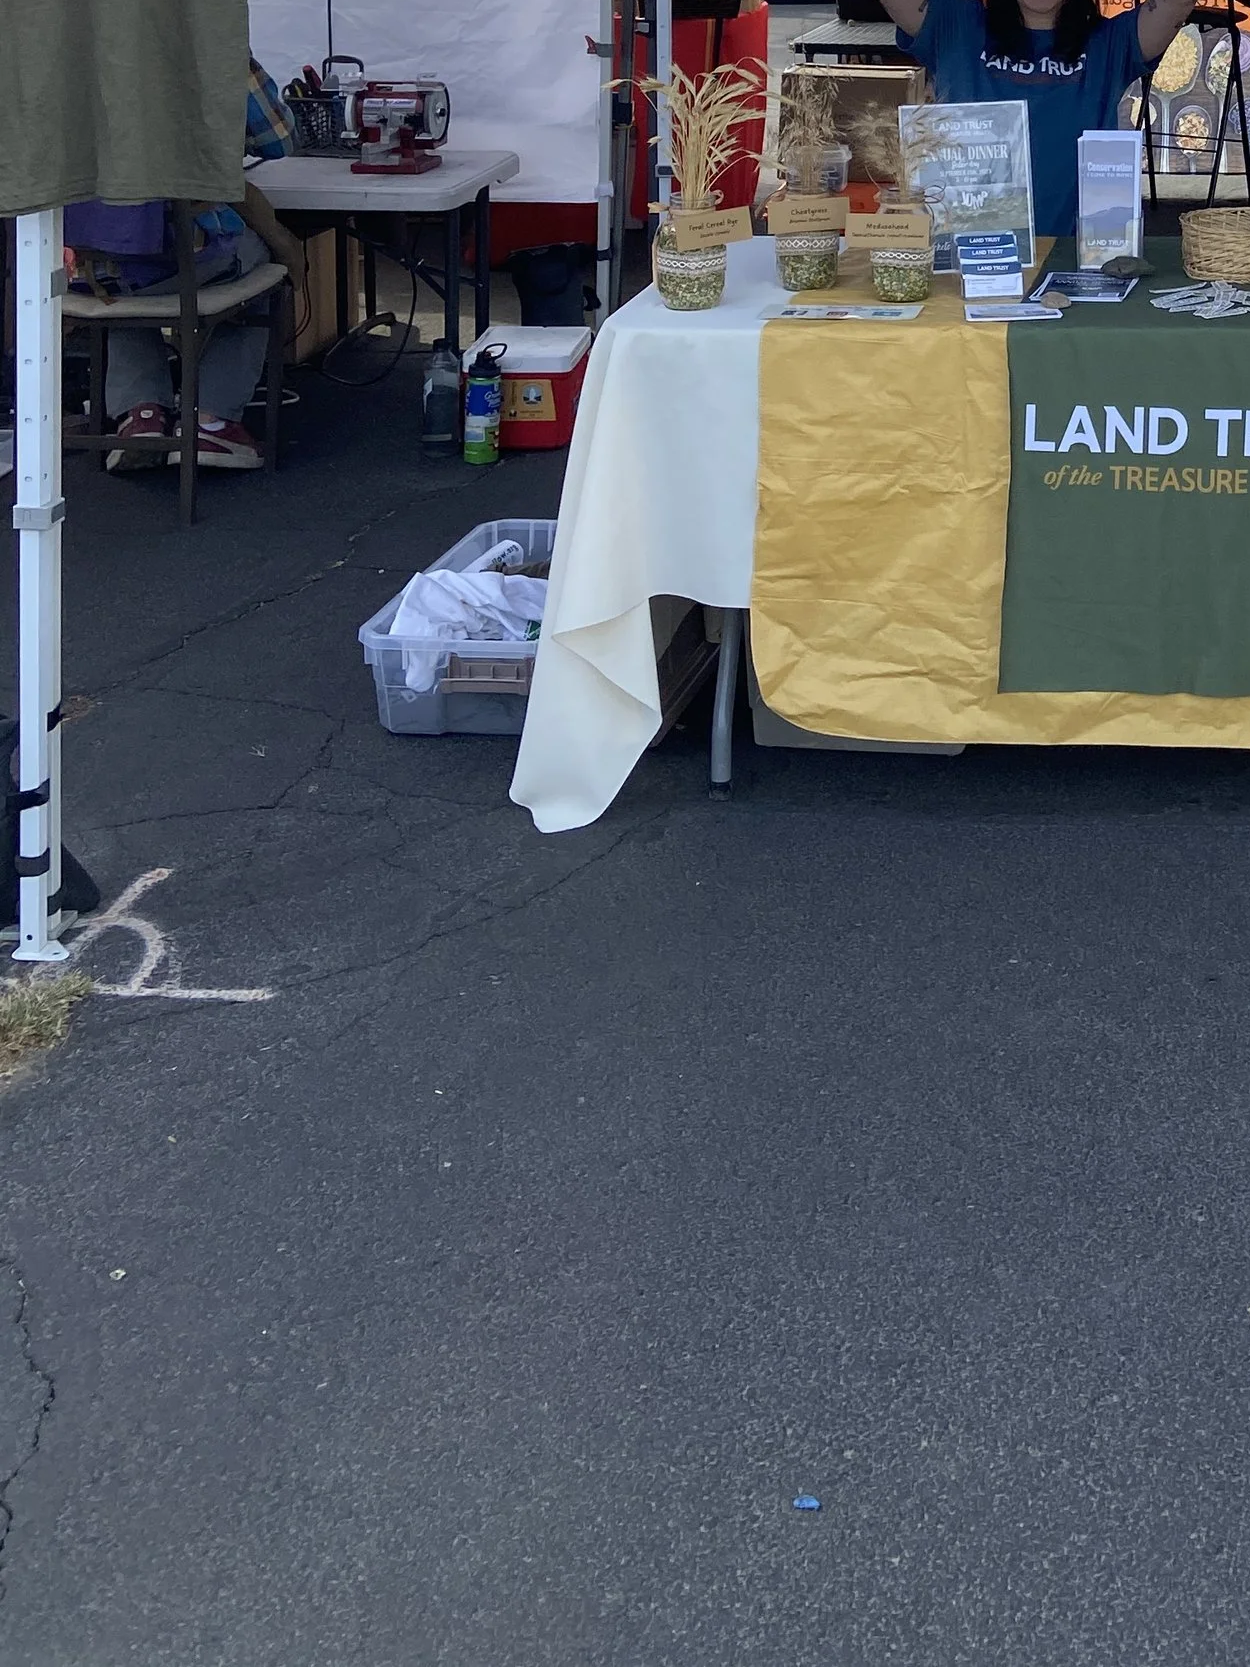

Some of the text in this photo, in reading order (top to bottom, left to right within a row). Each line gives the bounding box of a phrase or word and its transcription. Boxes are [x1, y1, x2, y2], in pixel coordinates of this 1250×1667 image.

[964, 119, 994, 130] TRUST
[968, 144, 1009, 161] DINNER
[1087, 162, 1134, 173] Conservation
[961, 190, 988, 210] JUMP
[790, 207, 828, 217] Cheatgrass
[865, 222, 909, 230] Medusahead
[1023, 403, 1190, 456] LAND
[1043, 464, 1071, 492] of
[1068, 465, 1103, 487] the
[1109, 465, 1249, 495] TREASURE
